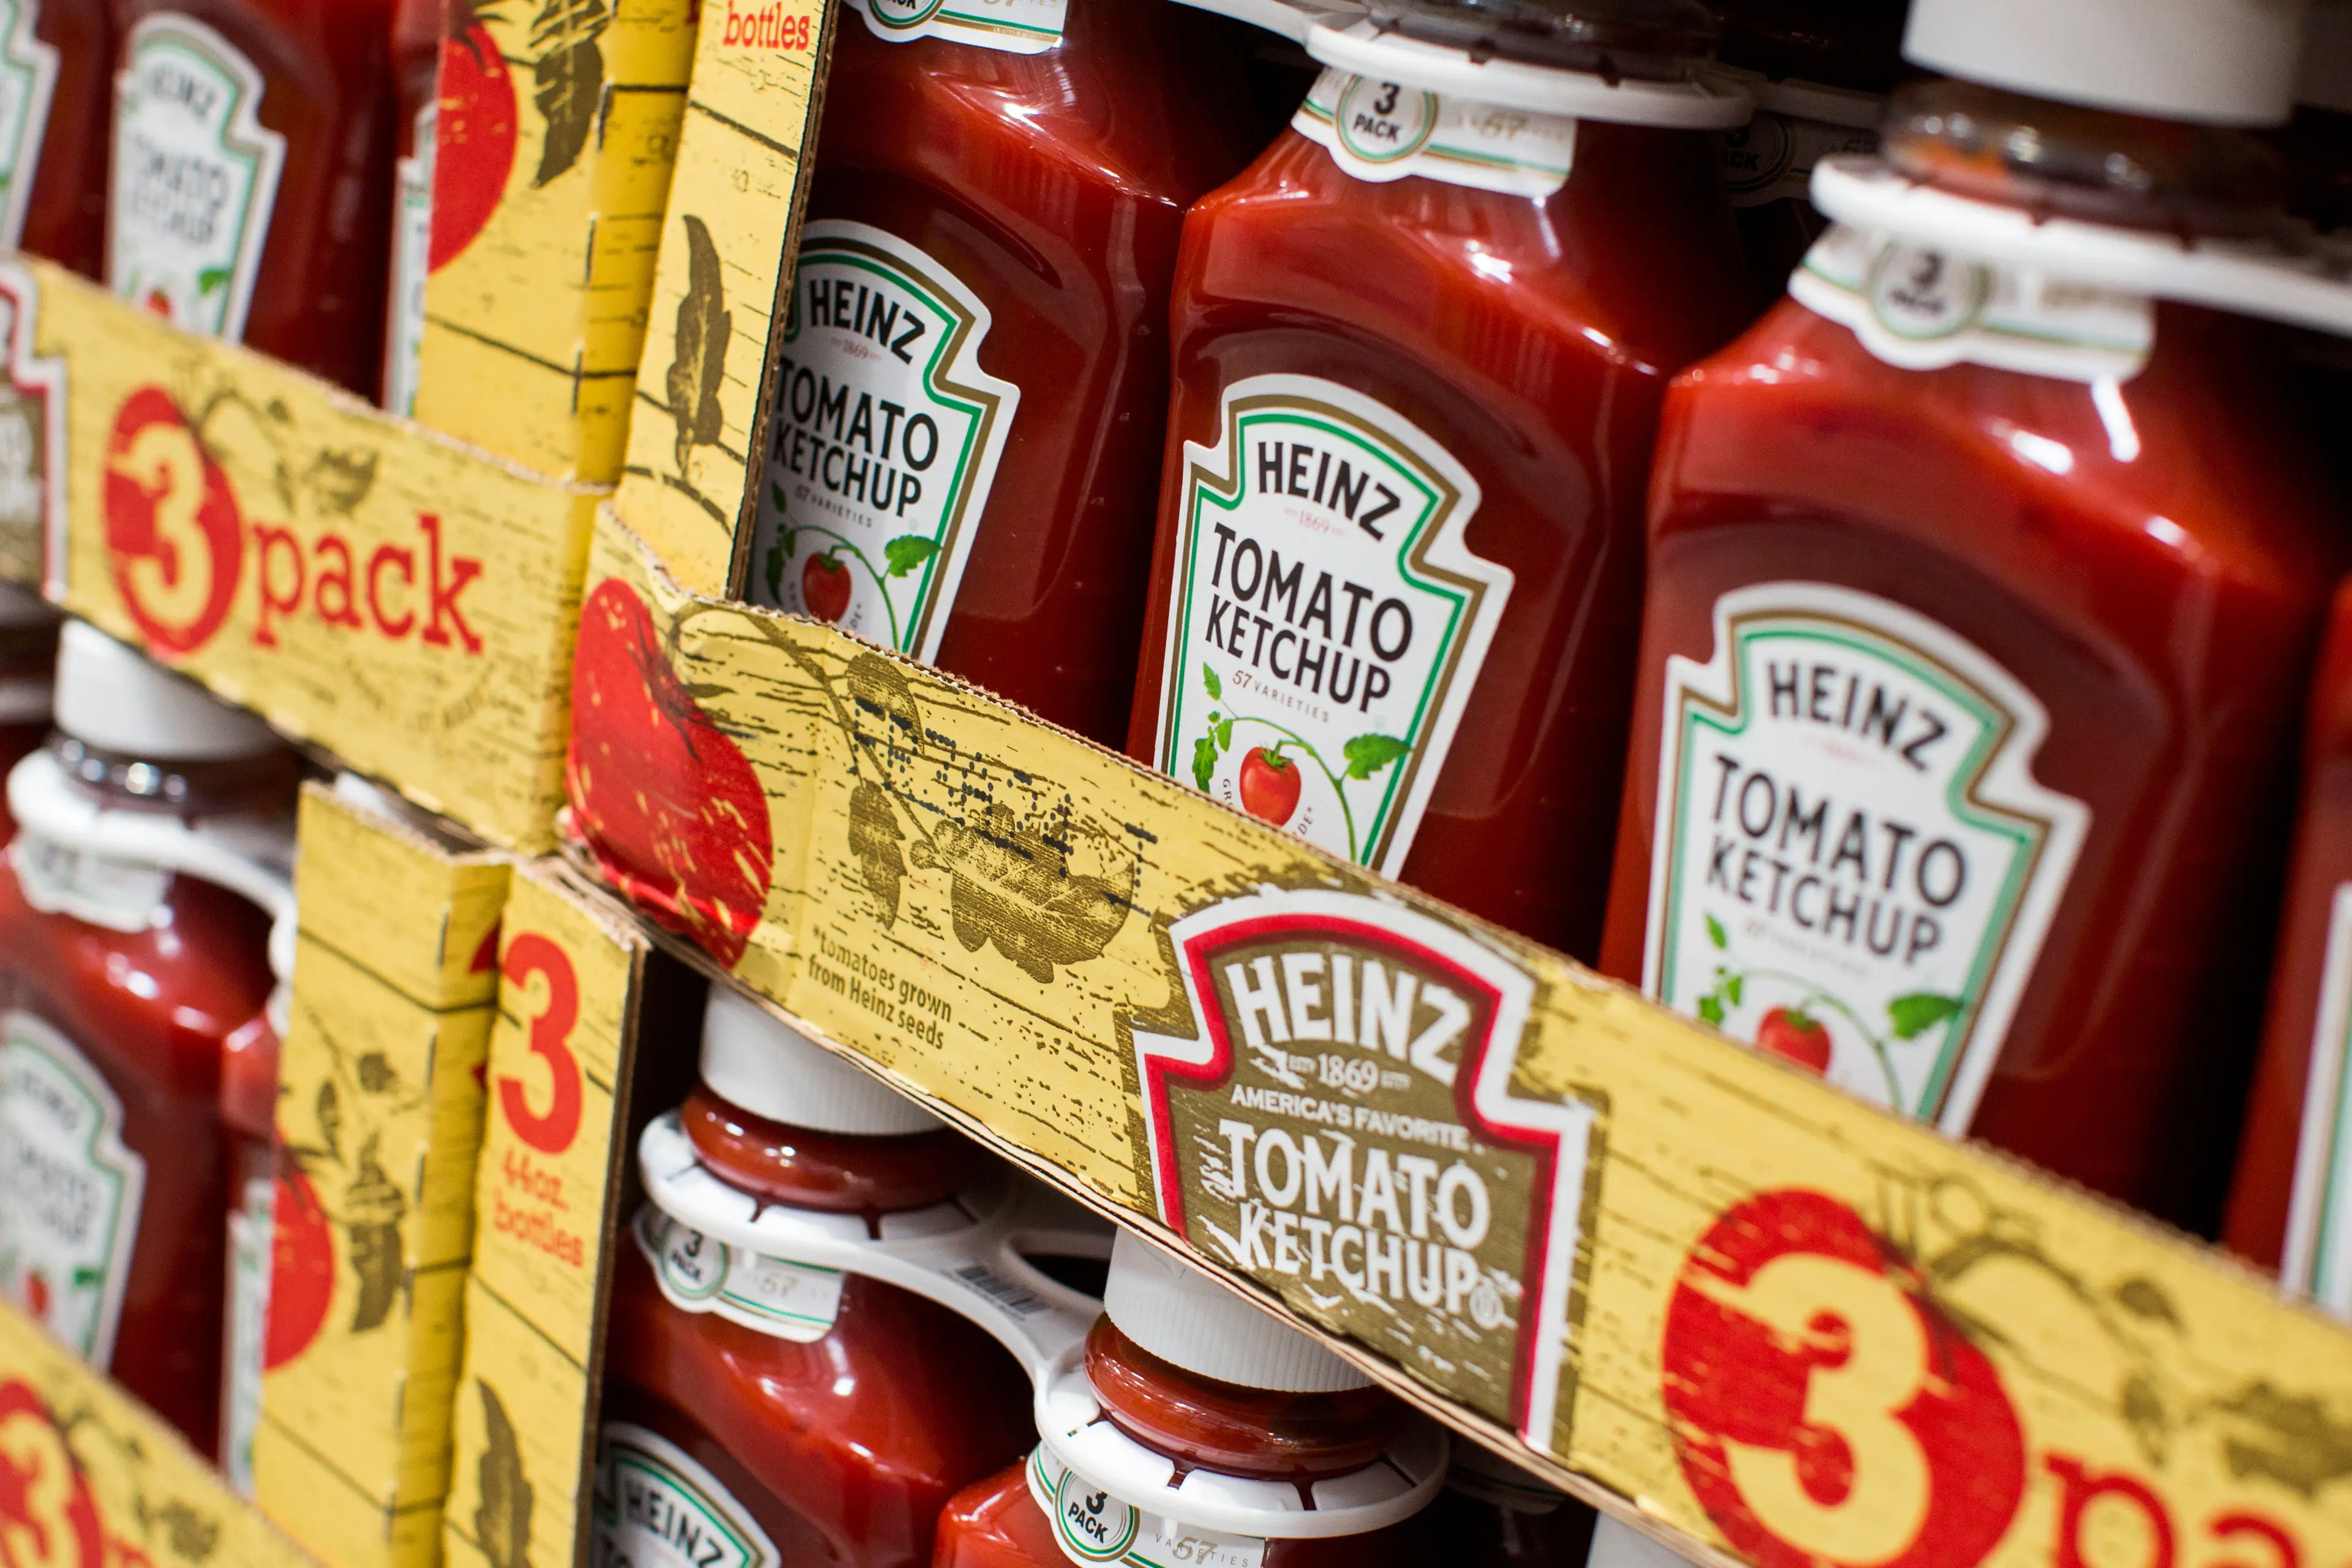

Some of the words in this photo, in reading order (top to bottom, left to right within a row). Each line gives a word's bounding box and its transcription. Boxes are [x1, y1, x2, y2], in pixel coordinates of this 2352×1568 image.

[723, 0, 810, 51] bottles
[1352, 115, 1402, 142] PACK
[1374, 81, 1400, 115] 3
[810, 279, 925, 364] HEINZ
[777, 355, 939, 472] TOMATO
[772, 418, 922, 518] KETCHUP
[812, 496, 873, 528] VARIETIES
[1257, 440, 1402, 541] HEINZ
[109, 421, 214, 638] 3
[251, 512, 484, 656] pack
[1210, 522, 1414, 662] TOMATO
[1204, 594, 1392, 713] KETCHUP
[1232, 669, 1253, 689] 57
[1254, 680, 1329, 723] VARIETIES
[1767, 659, 1947, 772] HEINZ
[1711, 754, 1967, 908] TOMATO
[1707, 835, 1942, 966] KETCHUP
[497, 930, 584, 1155] 3
[809, 953, 846, 995] from
[850, 976, 895, 1023] Heinz
[897, 1009, 944, 1050] seeds
[898, 979, 952, 1022] grown
[1224, 952, 1471, 1087] HEINZ
[1231, 1084, 1353, 1128] AMERICA'S
[1354, 1106, 1471, 1153] FAVORITE
[1317, 1053, 1378, 1093] 1869
[492, 1188, 585, 1269] bottles
[1219, 1118, 1491, 1250] TOMATO
[1239, 1199, 1479, 1314] KETCHUP
[1681, 1252, 1932, 1566] 3
[625, 1477, 725, 1568] HEINZ
[1068, 1501, 1109, 1544] PACK
